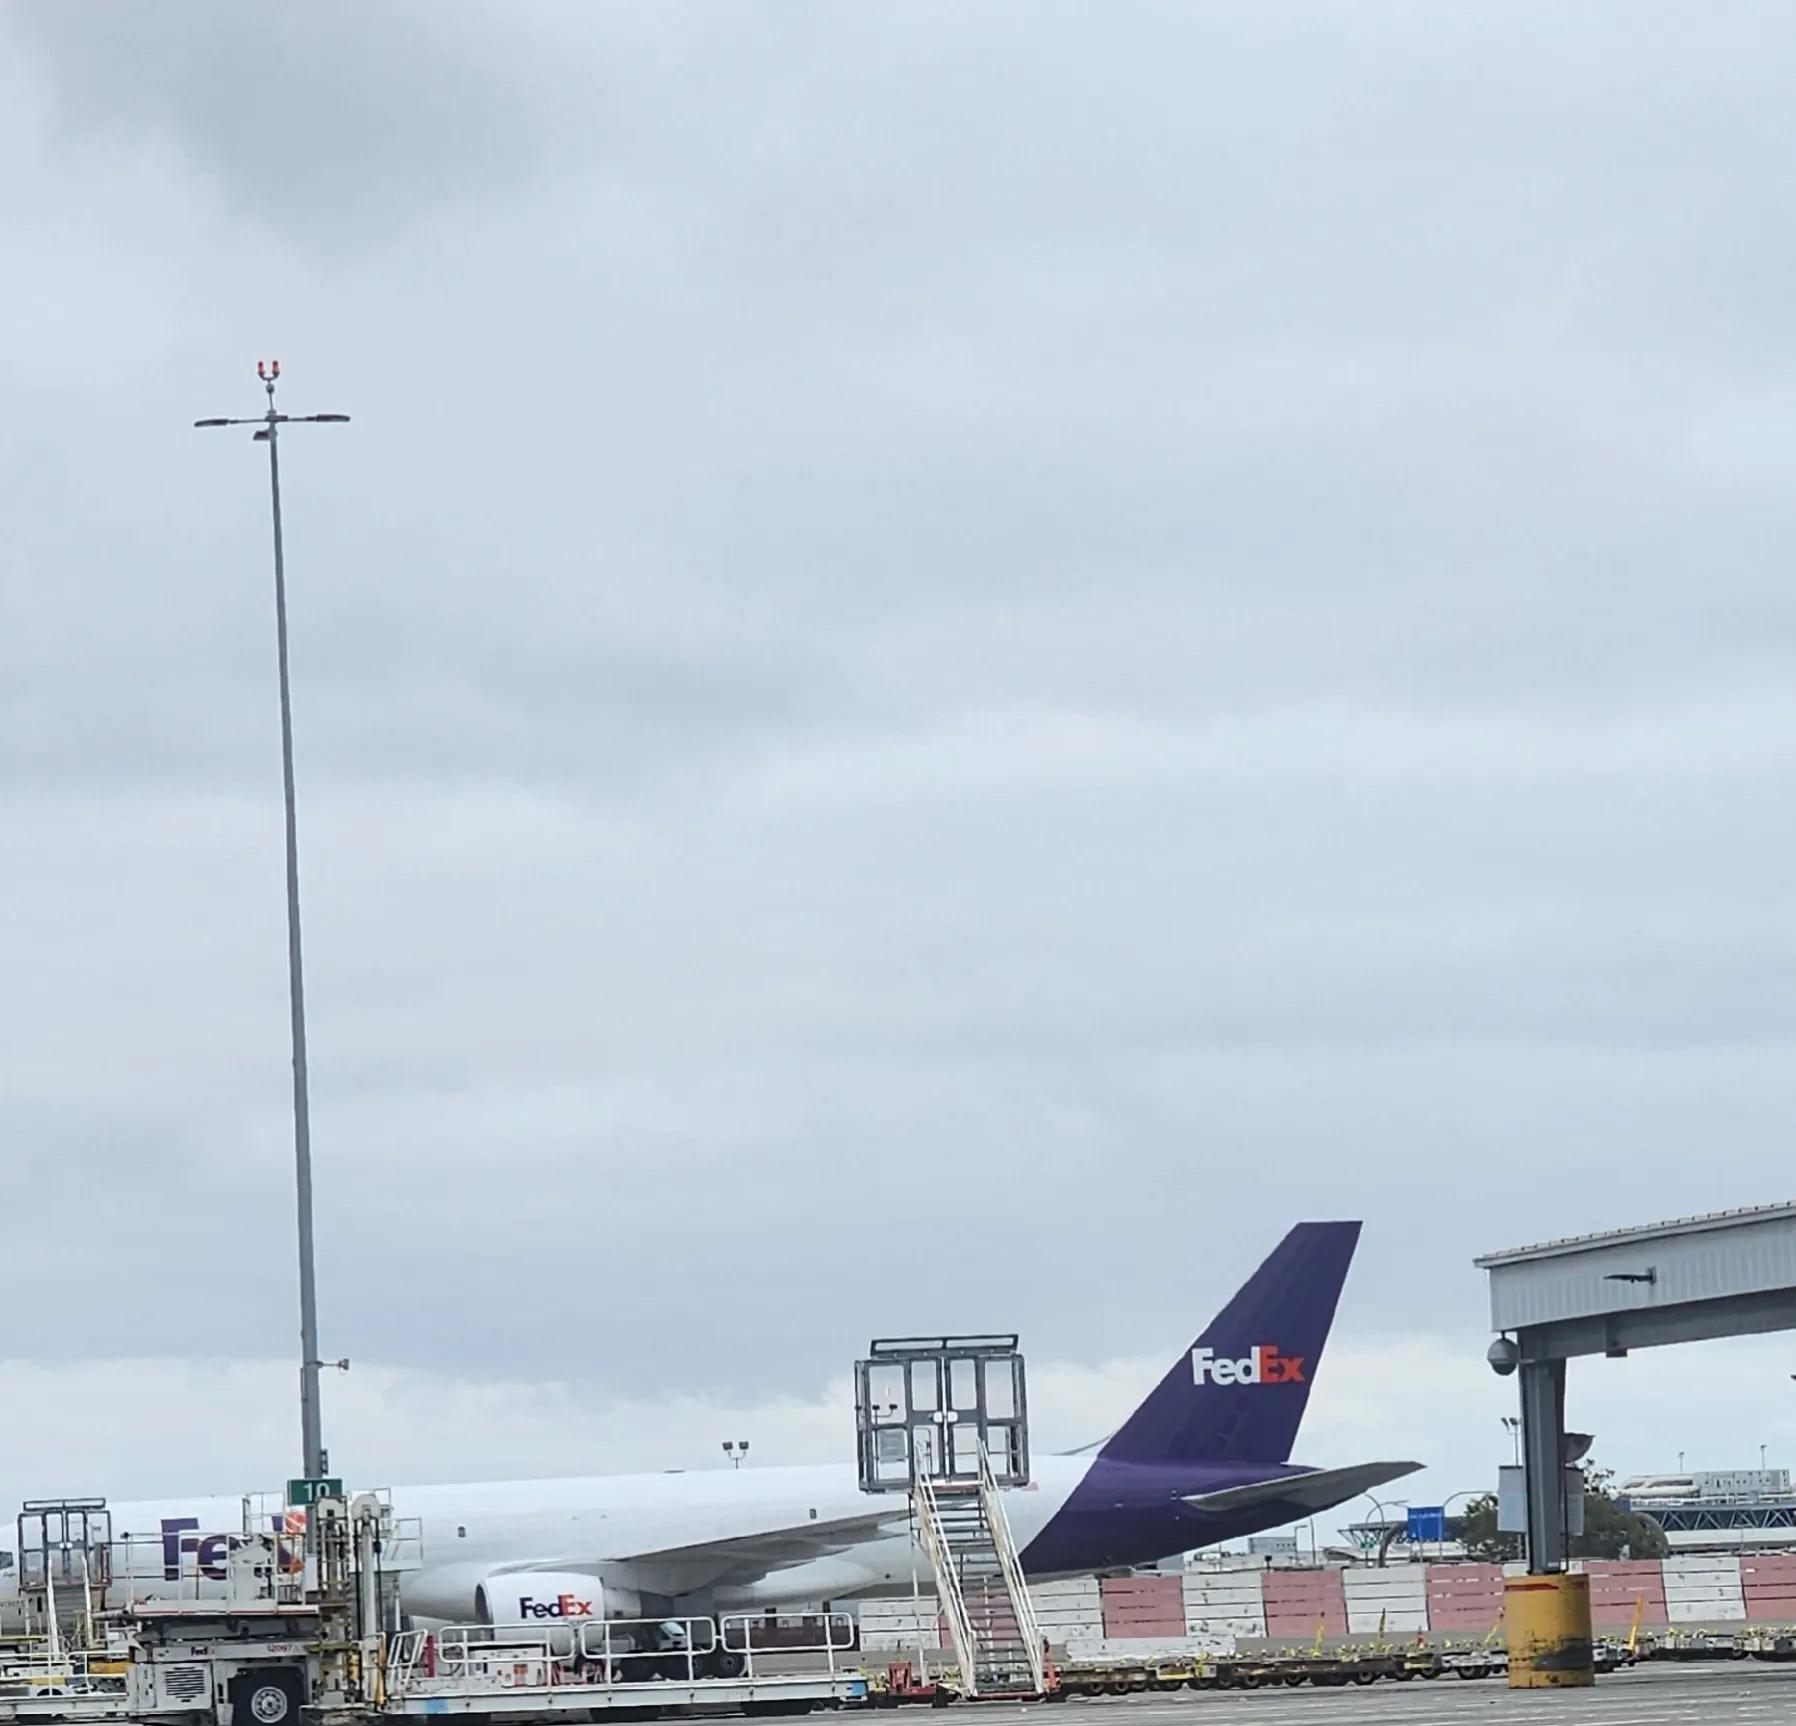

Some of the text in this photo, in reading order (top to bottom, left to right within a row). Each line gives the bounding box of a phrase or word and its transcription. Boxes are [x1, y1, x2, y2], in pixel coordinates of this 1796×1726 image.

[1191, 1345, 1306, 1385] FedEx
[303, 1482, 330, 1501] 10
[519, 1594, 593, 1619] FedEx
